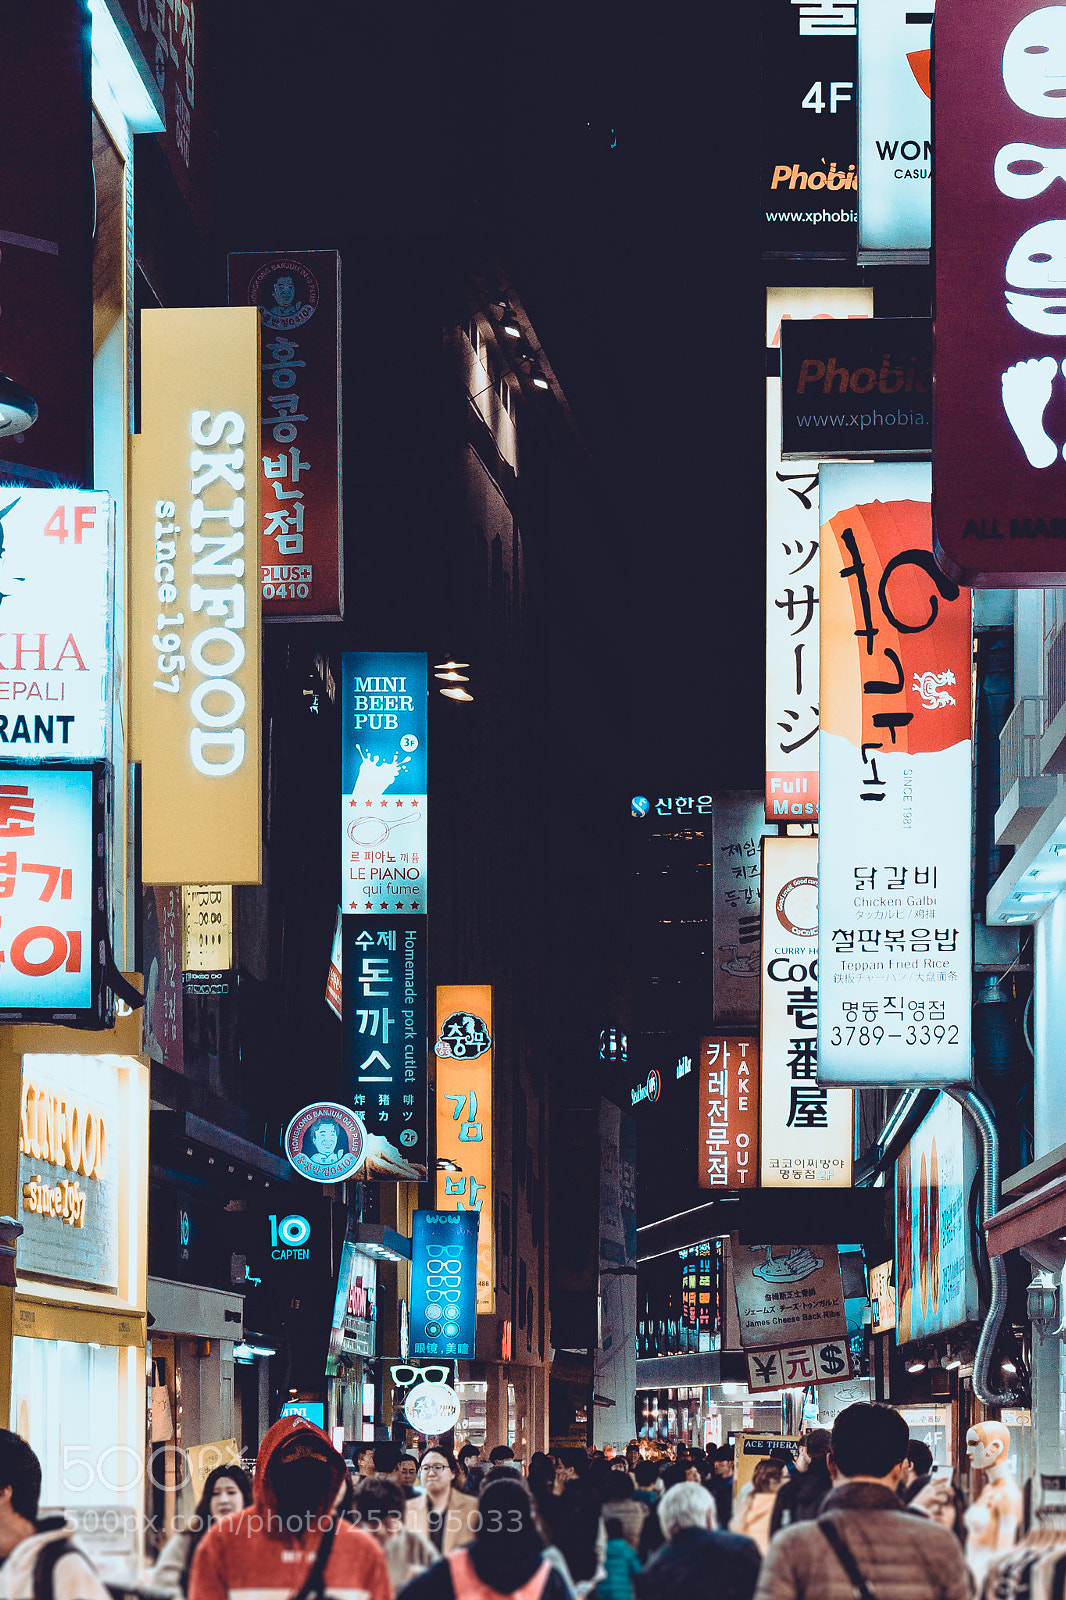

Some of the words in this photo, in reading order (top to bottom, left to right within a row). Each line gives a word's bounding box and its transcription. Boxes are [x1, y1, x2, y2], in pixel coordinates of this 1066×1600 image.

[802, 82, 853, 114] 4F
[771, 157, 857, 191] Phobi
[260, 336, 311, 555] 홍콩반점
[44, 505, 97, 545] 4F
[155, 499, 179, 603] since
[190, 409, 246, 777] SKINFOOD
[263, 583, 309, 600] 0410
[775, 470, 820, 755] マッサージ
[0, 633, 90, 671] HA
[153, 611, 186, 694] 1957
[354, 676, 407, 693] MINI
[354, 695, 415, 712] BEER
[354, 713, 399, 730] PUB
[404, 737, 415, 748] 3F
[770, 777, 808, 794] Full
[903, 769, 913, 802] SINCE
[654, 795, 712, 815] 신한은
[903, 806, 913, 829] 1981
[350, 851, 360, 862] 르
[364, 850, 396, 864] 피아노
[350, 867, 366, 880] LE
[370, 867, 420, 880] PIANO
[854, 866, 938, 891] 닭갈비
[362, 882, 382, 898] qui
[386, 881, 420, 895] fume
[853, 896, 902, 907] Chicken
[906, 895, 937, 907] Galbi
[0, 915, 82, 977] 이
[355, 930, 397, 951] 수제
[774, 947, 806, 955] CURRY
[831, 928, 960, 953] 철판볶음밥
[404, 930, 418, 1004] Homemade
[841, 960, 884, 973] Teppan
[889, 959, 919, 970] Fried
[924, 958, 950, 969] Rice
[355, 958, 395, 1083] 돈까스
[842, 996, 945, 1022] 명동직영점
[401, 1009, 418, 1039] pork
[831, 1024, 959, 1046] 3789-3392
[442, 1022, 487, 1056] 충무
[404, 1045, 418, 1083] cutlet
[737, 1043, 750, 1111] TAKE
[706, 1041, 731, 1185] 카레전문점
[292, 1113, 313, 1152] HONGKONG
[312, 1109, 343, 1119] BANJUM
[342, 1116, 356, 1132] 0410
[351, 1133, 359, 1152] PLUS
[404, 1132, 416, 1142] 2F
[736, 1133, 750, 1184] OUT
[780, 1169, 815, 1180] 명동점
[817, 1169, 834, 1181] 2F
[28, 1174, 62, 1218] since
[425, 1214, 461, 1224] WOW
[271, 1249, 310, 1260] CAPTEN
[745, 1319, 771, 1328] James
[772, 1315, 800, 1325] Cheese
[802, 1312, 822, 1321] Back
[823, 1310, 841, 1319] Ribs
[786, 1349, 813, 1380] 元
[820, 1344, 846, 1376] $
[745, 1440, 764, 1448] ACE
[767, 1441, 798, 1449] THERA
[923, 1431, 943, 1447] 4F
